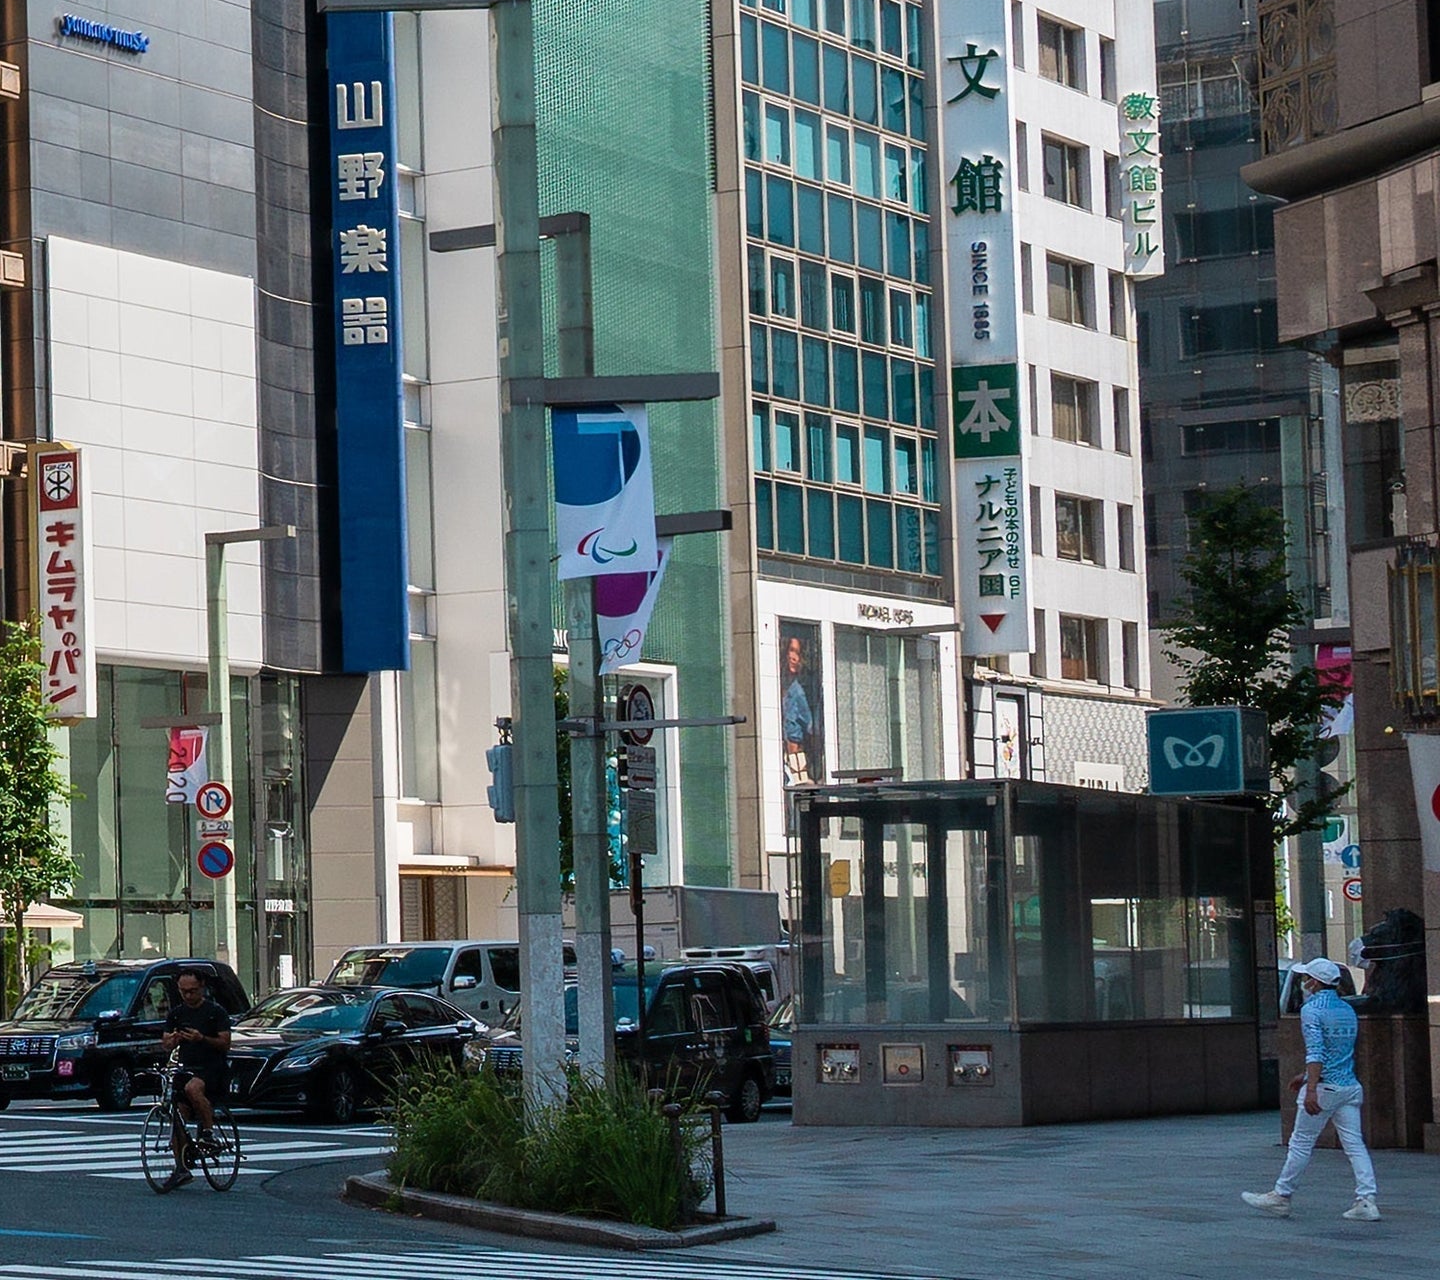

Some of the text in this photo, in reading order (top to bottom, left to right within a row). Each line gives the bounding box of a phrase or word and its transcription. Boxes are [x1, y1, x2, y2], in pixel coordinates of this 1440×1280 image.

[335, 80, 389, 346] 山野楽器
[1124, 92, 1161, 263] 教文館ビル
[971, 241, 991, 340] SINCE 1885
[957, 381, 1012, 443] 本
[975, 474, 1005, 597] ナルニア国
[1003, 468, 1019, 569] 子どもの本のみせ
[46, 521, 80, 704] キムラヤのパン
[166, 747, 188, 804] 2020
